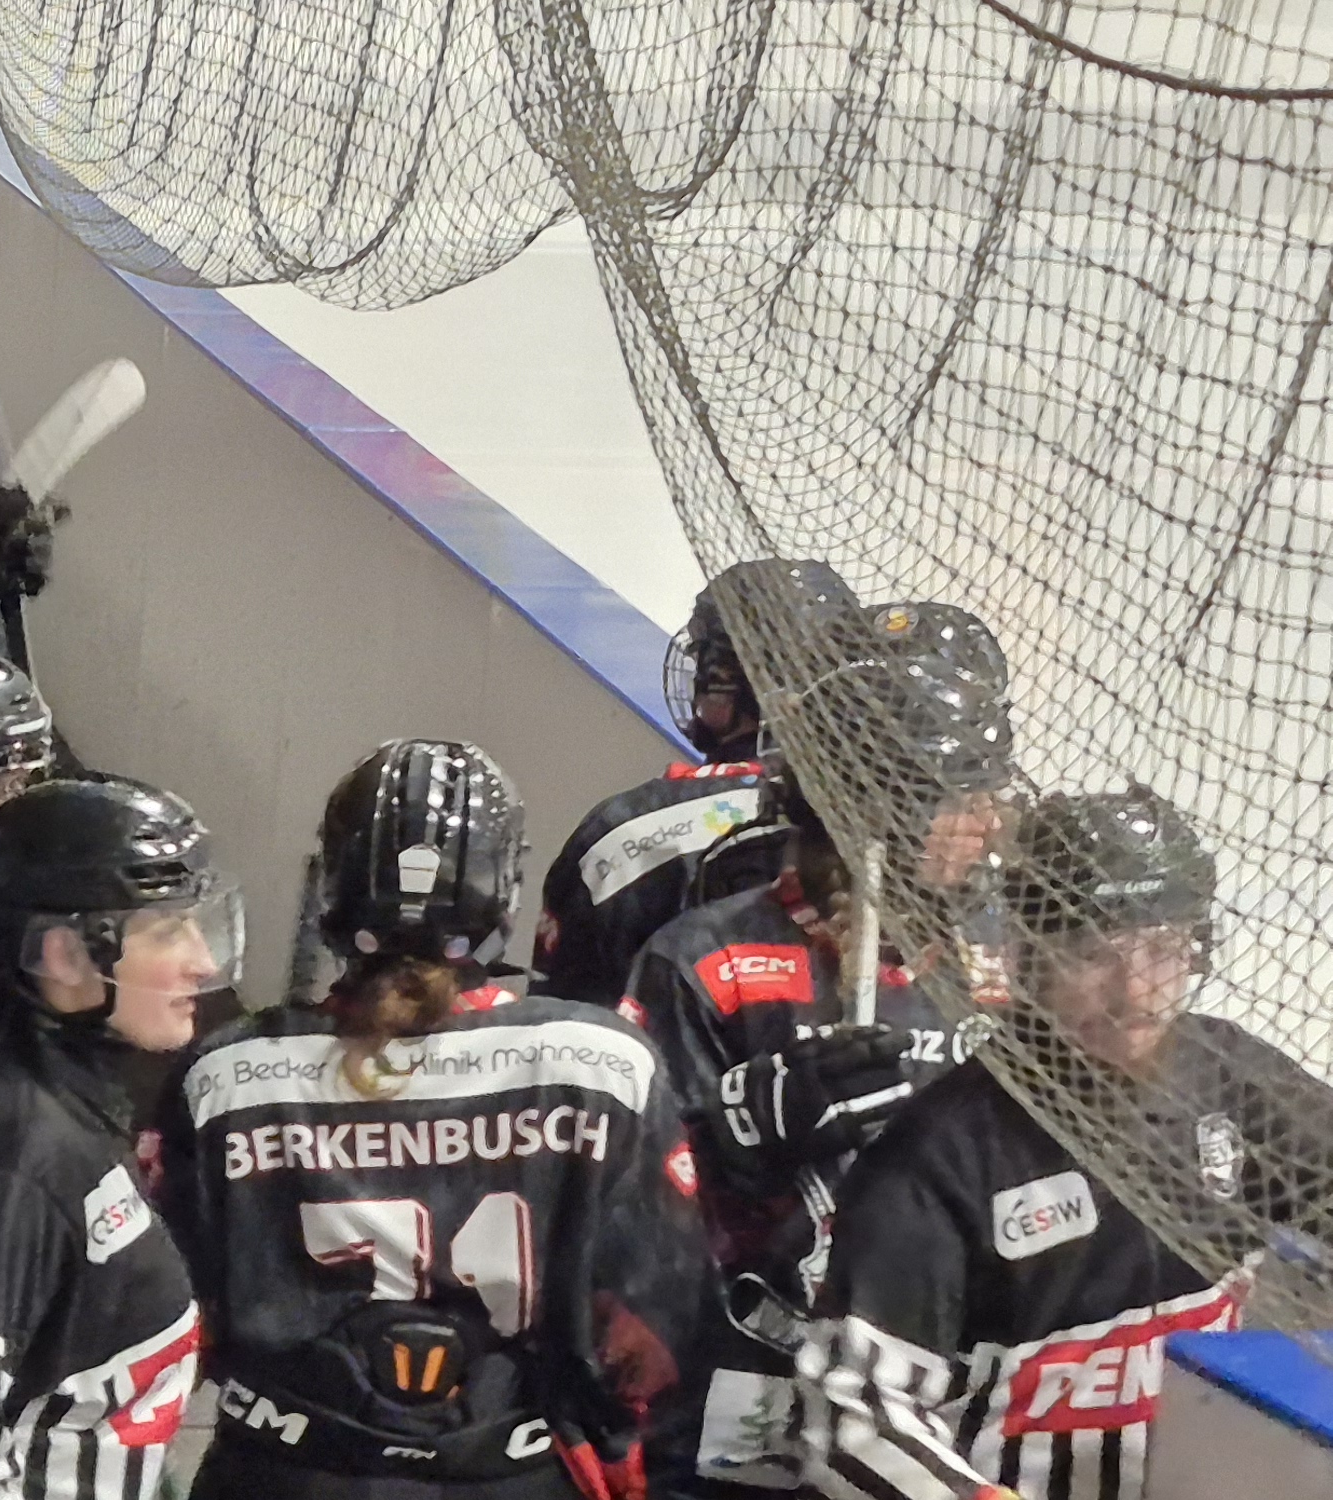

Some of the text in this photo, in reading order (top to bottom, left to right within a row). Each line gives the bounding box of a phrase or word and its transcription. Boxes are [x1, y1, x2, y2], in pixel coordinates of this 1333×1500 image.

[621, 820, 694, 861] Becker
[718, 956, 796, 982] CCM
[234, 1057, 327, 1085] Becker
[224, 1104, 610, 1181] BERKENBUSCH
[1025, 1334, 1167, 1420] PEN
